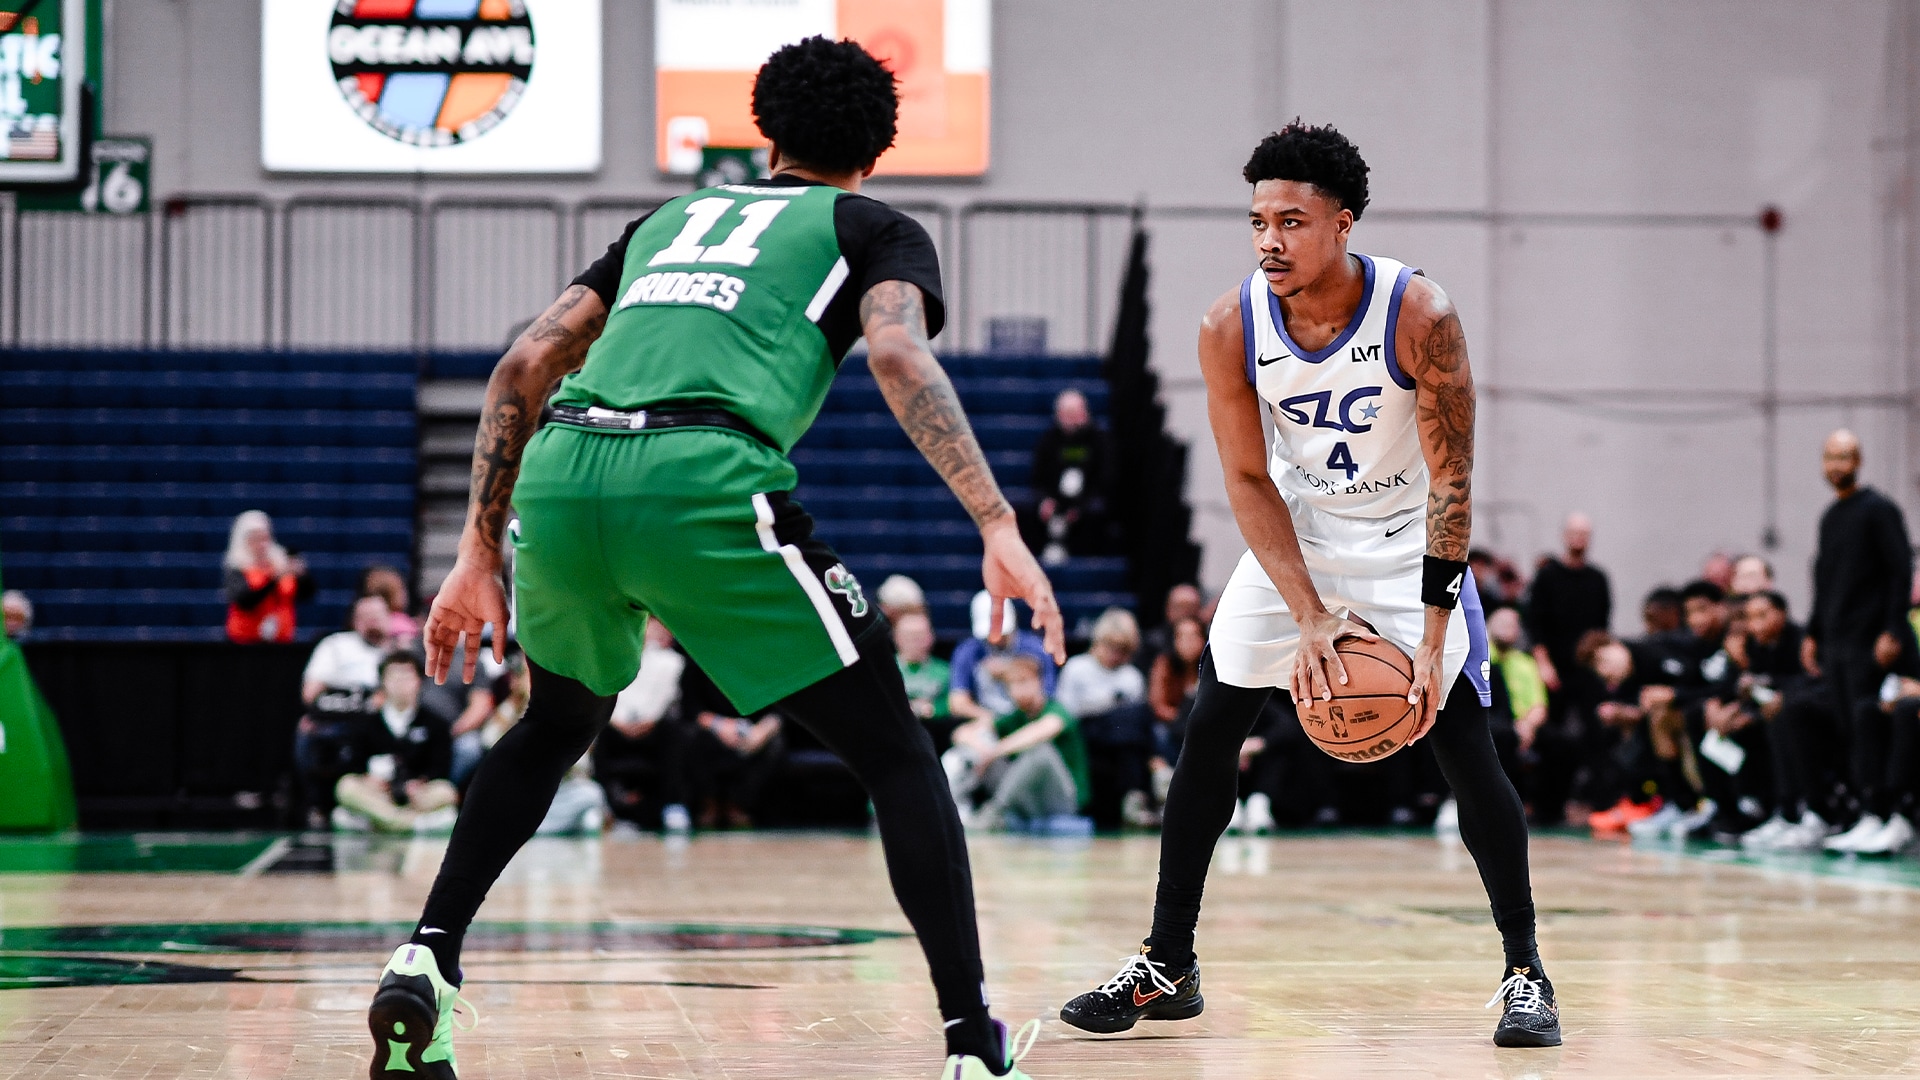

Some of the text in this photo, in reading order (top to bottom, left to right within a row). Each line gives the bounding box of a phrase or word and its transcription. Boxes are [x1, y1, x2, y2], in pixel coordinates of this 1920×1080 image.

[329, 24, 462, 65] OCEAN
[647, 197, 790, 267] 11
[618, 271, 745, 311] BRIDGES
[1352, 344, 1382, 362] LVT
[1279, 386, 1383, 434] SLC
[1326, 442, 1359, 481] 4
[1344, 468, 1409, 495] BANK
[1446, 572, 1463, 600] 4
